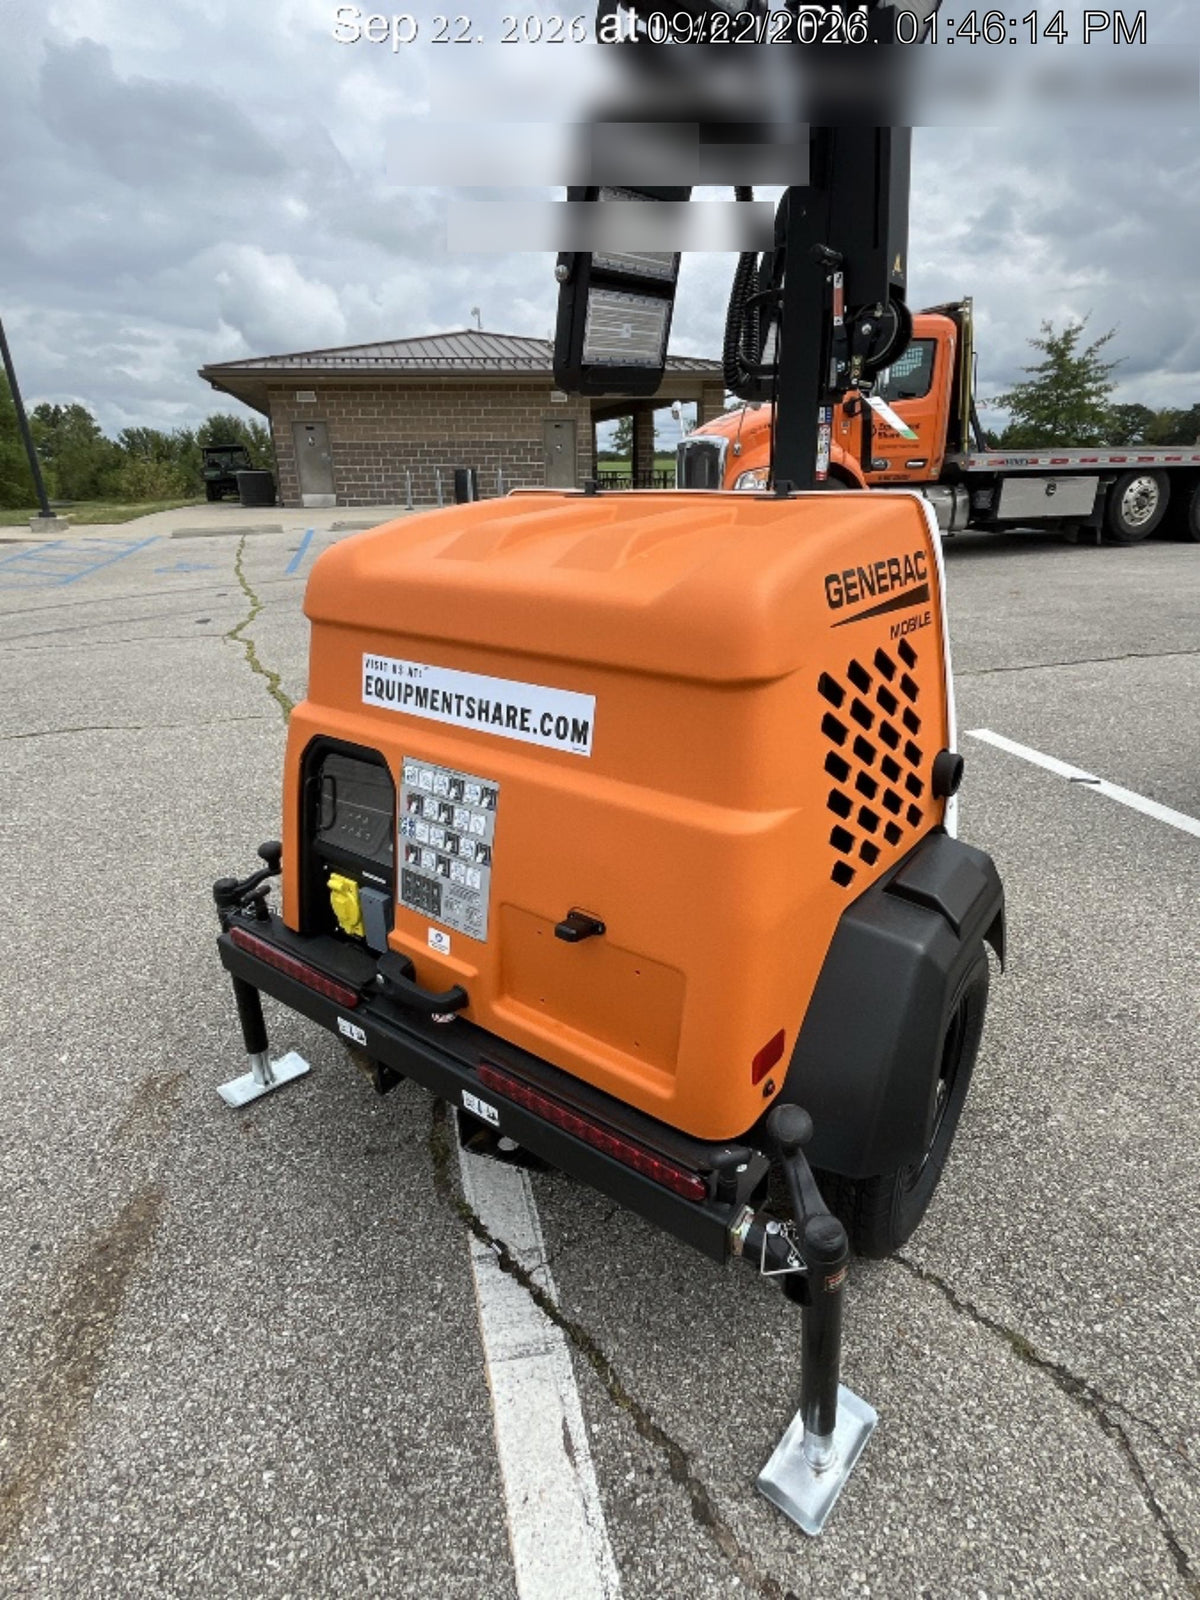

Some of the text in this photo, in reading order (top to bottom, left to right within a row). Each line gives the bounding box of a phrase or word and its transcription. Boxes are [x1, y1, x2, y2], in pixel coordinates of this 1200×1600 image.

[825, 550, 927, 610] GENERAC
[890, 611, 931, 640] MOBILE
[365, 658, 388, 672] VISIT
[365, 675, 589, 746] EQUIPMENTSHARE.COM
